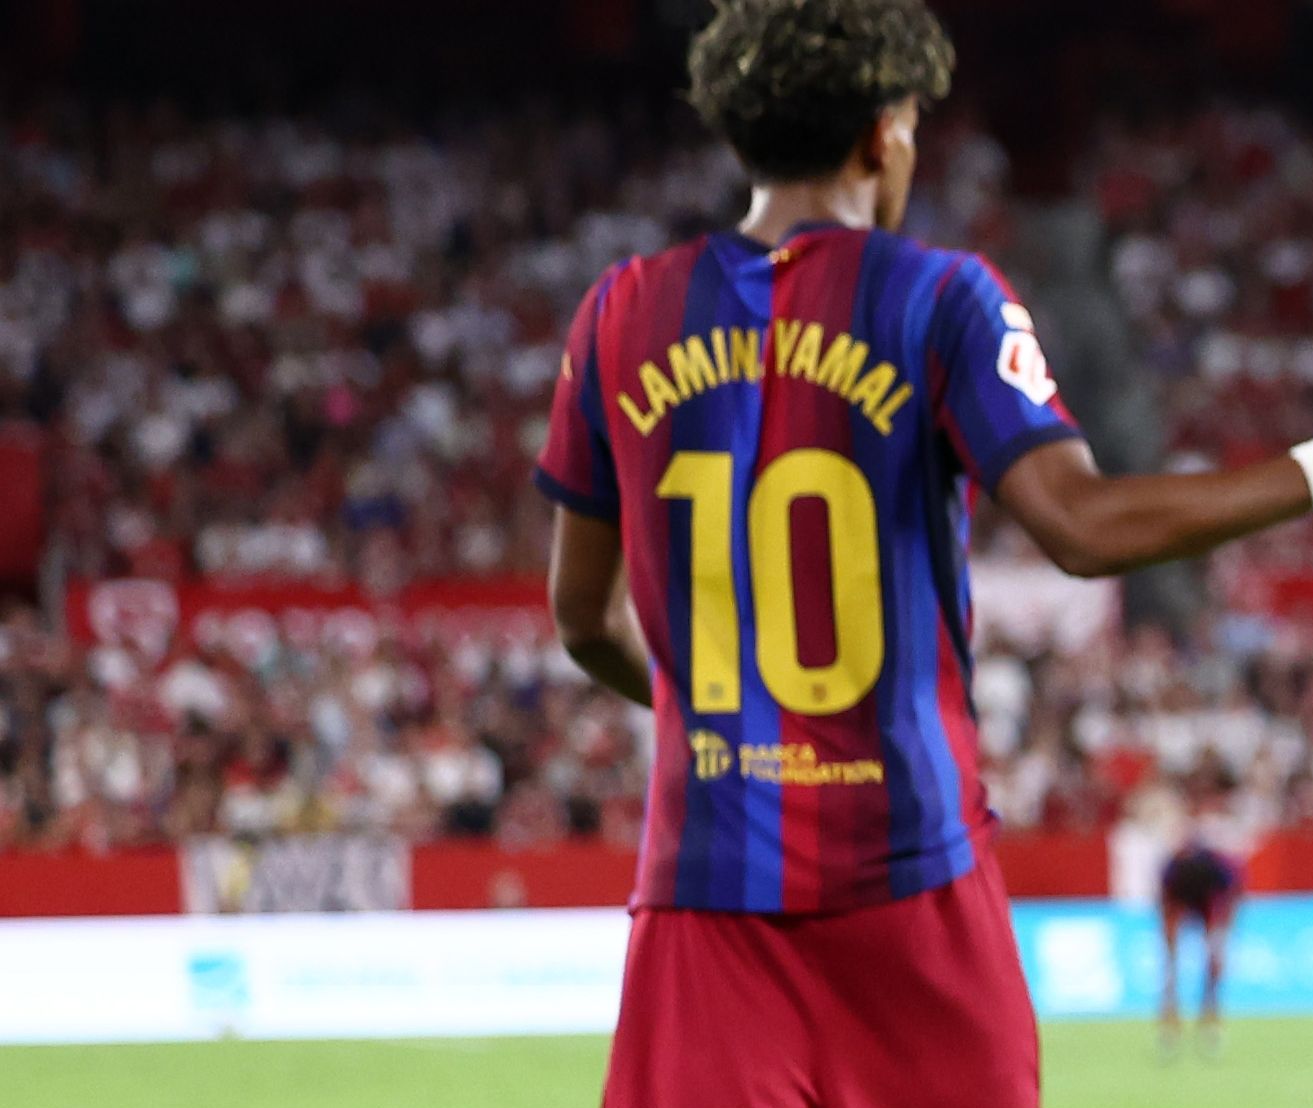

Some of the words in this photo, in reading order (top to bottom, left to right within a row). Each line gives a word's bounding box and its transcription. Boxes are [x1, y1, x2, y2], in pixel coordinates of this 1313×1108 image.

[617, 326, 766, 436] LAMIN
[774, 318, 914, 436] YAMAL
[656, 449, 884, 716] 10
